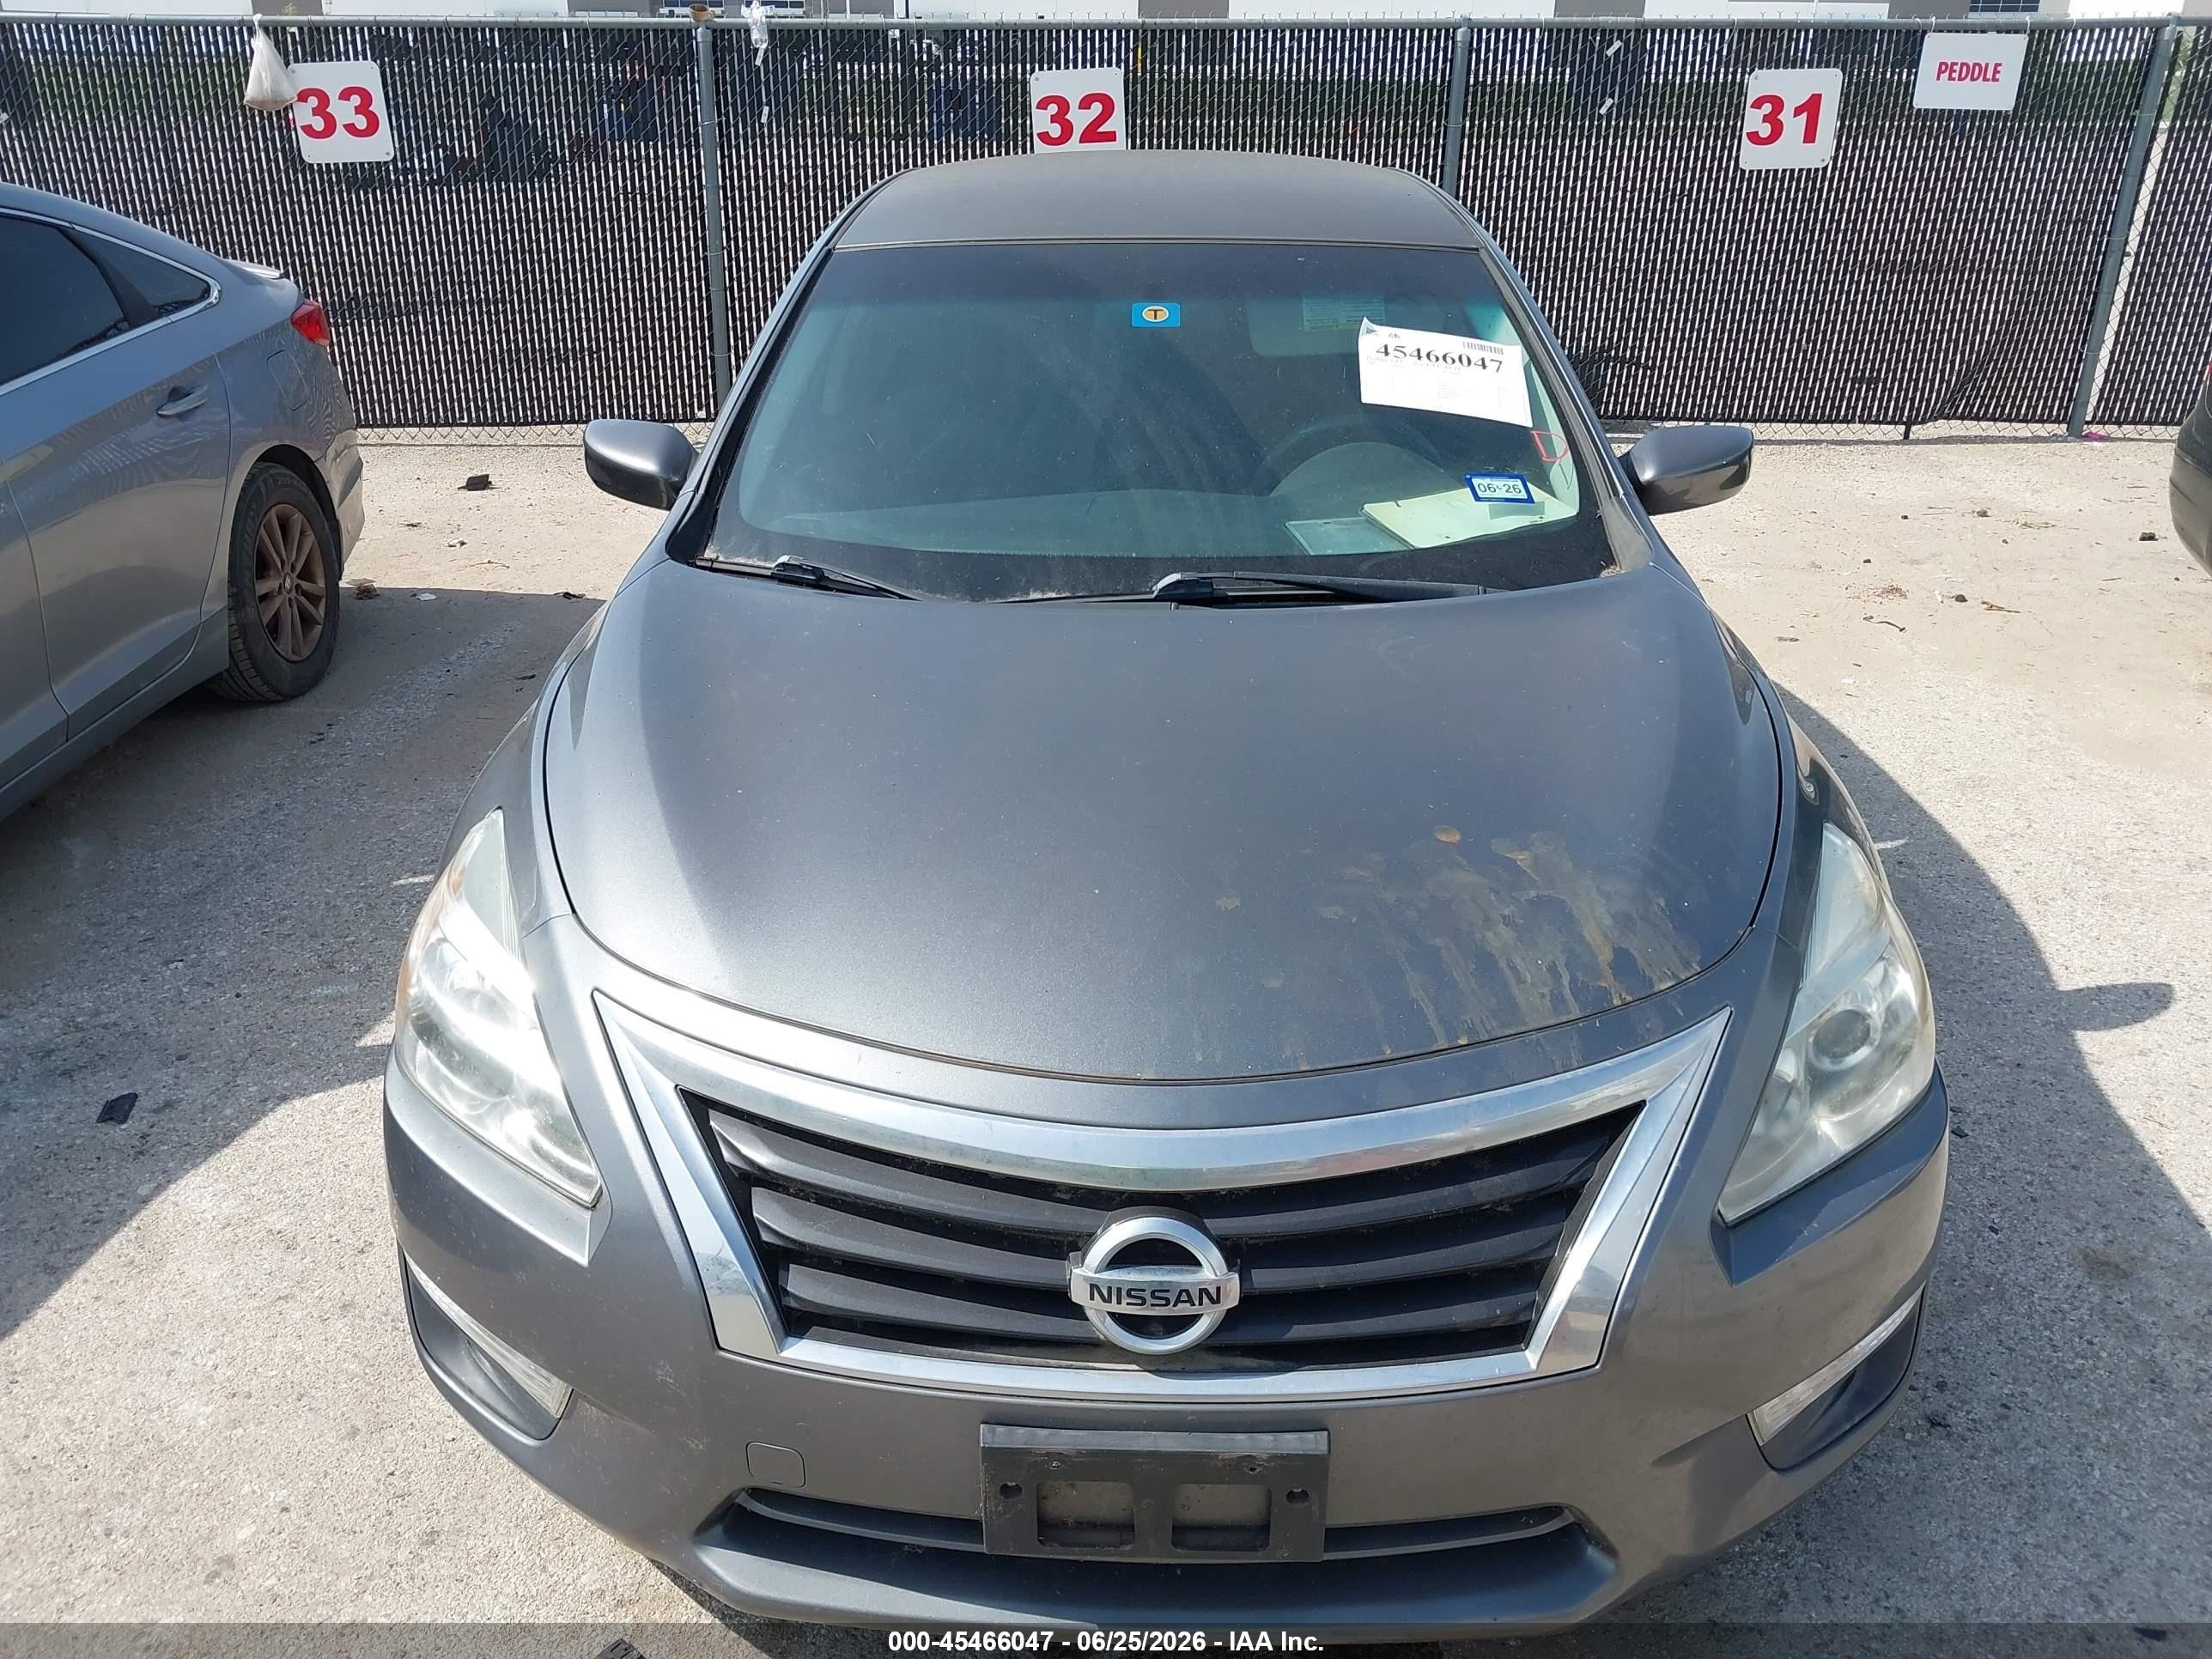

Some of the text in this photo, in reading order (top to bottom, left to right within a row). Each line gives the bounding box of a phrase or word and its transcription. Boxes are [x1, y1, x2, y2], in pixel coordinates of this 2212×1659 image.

[1936, 61, 2002, 82] PEDDLE
[296, 86, 380, 139] 33
[1036, 93, 1117, 146] 32
[1746, 93, 1823, 146] 31
[1147, 308, 1164, 320] T
[1376, 343, 1504, 373] 45466047
[1089, 1283, 1222, 1308] NISSAN
